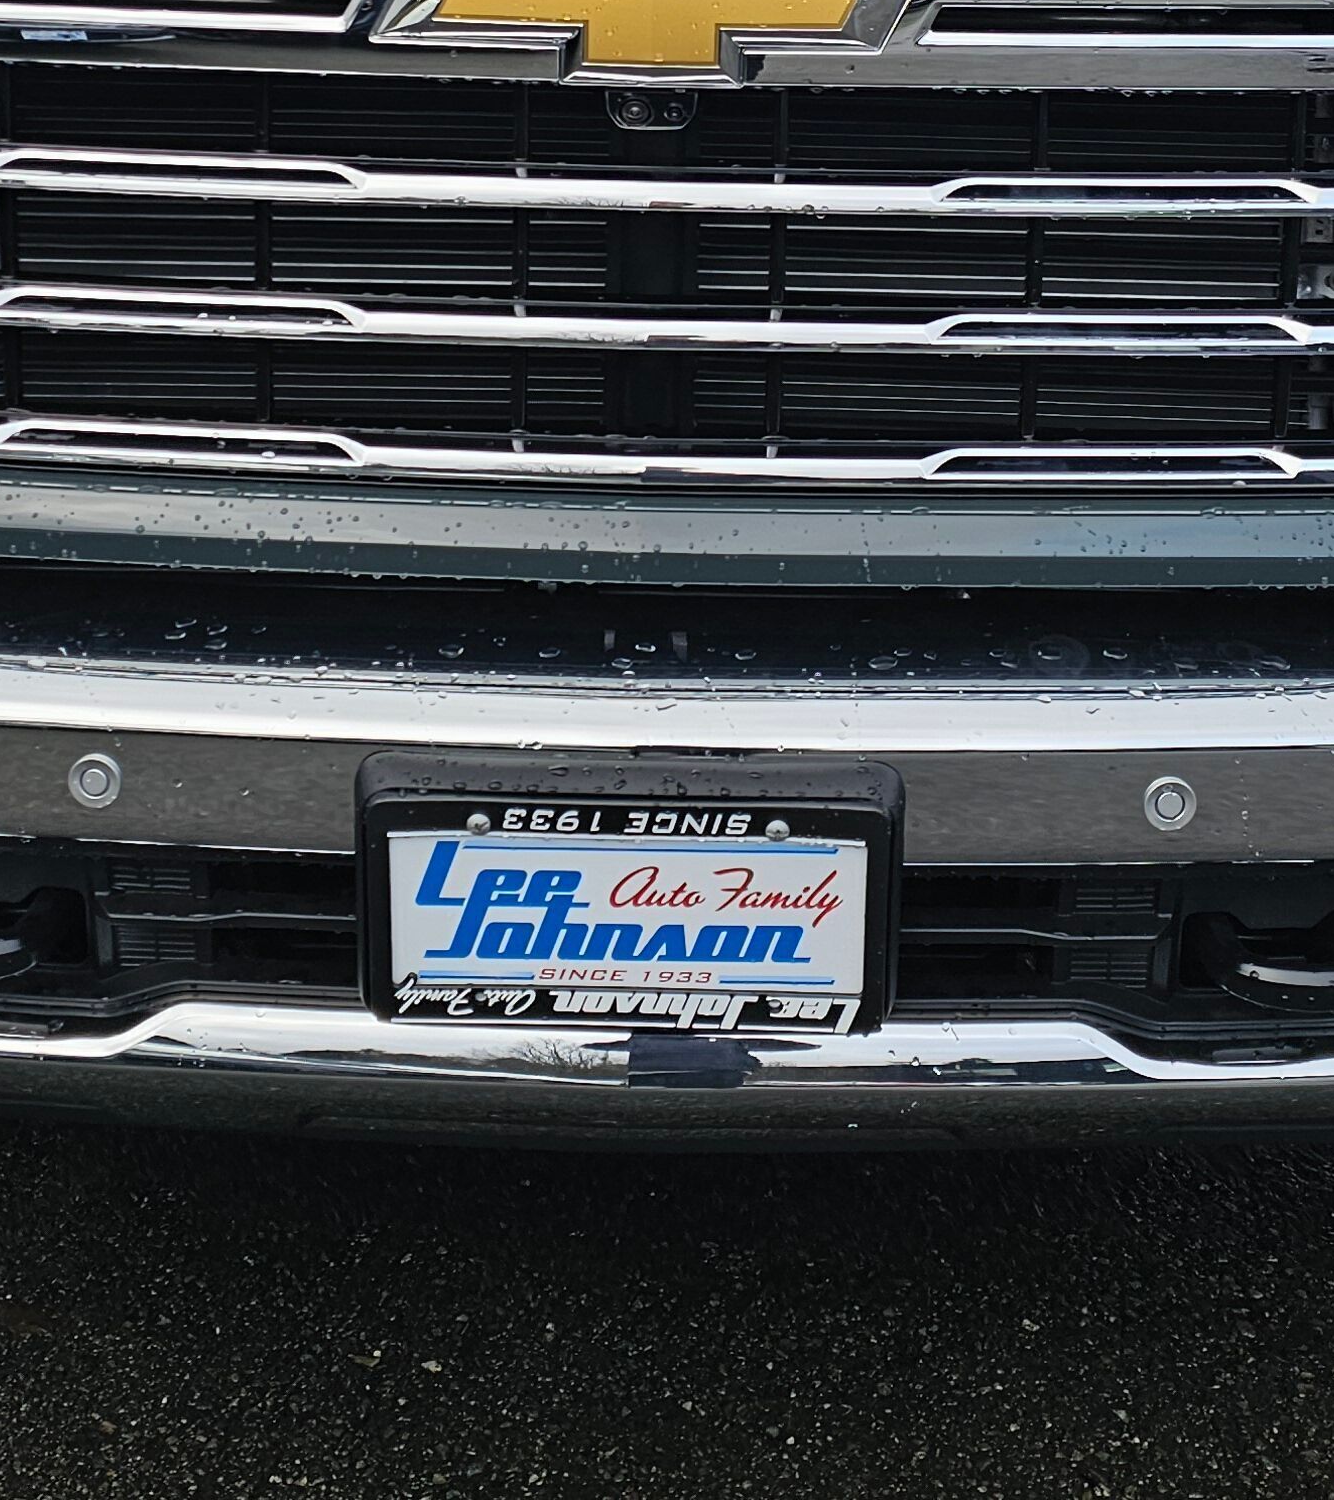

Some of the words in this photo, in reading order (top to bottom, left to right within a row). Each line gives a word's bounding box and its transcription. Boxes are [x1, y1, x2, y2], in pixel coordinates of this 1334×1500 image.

[502, 809, 604, 834] 1933
[625, 812, 751, 836] SINCE
[415, 840, 590, 908] Lee
[608, 866, 706, 911] Auto
[713, 868, 843, 927] Family
[423, 904, 811, 963] Johnson
[539, 967, 627, 982] SINCE
[642, 970, 713, 984] 1933
[393, 981, 474, 1017] Family
[549, 988, 759, 1030] Johnson
[766, 997, 861, 1035] Lee
